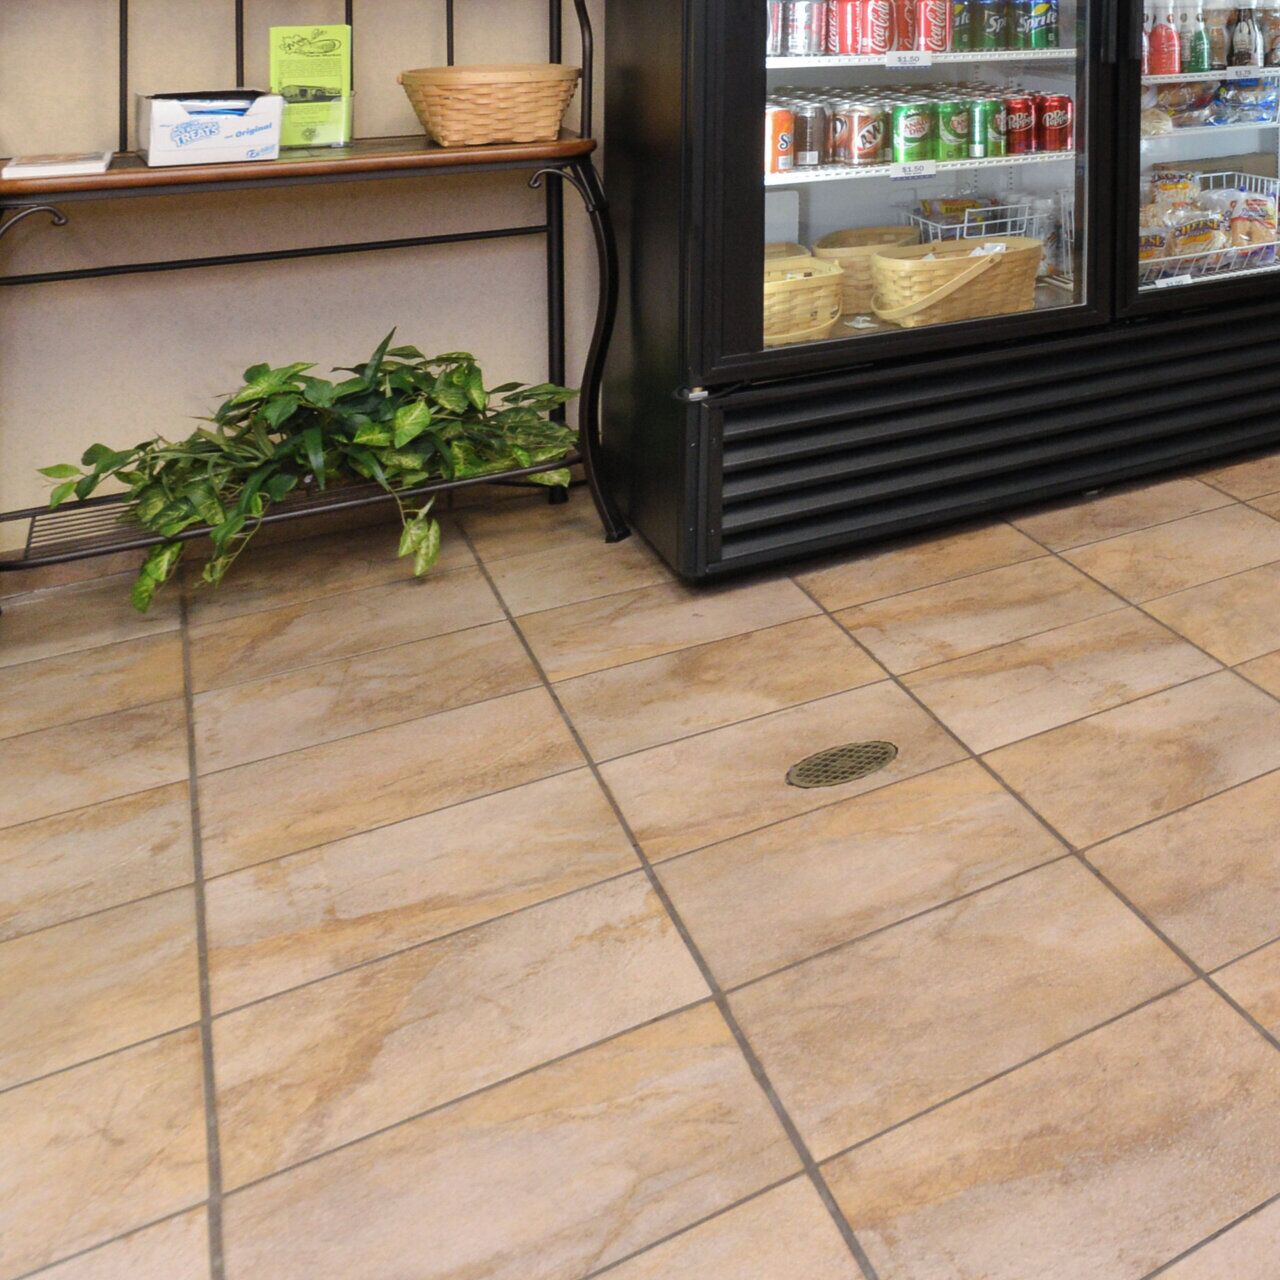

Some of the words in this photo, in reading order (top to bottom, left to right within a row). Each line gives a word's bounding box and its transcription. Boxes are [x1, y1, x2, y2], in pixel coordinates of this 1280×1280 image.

[869, 0, 892, 53] Coca-Cola
[1017, 7, 1058, 34] Sprite
[896, 55, 921, 63] $1.50
[174, 123, 220, 148] TREATS
[234, 122, 273, 139] Original
[859, 120, 883, 149] A&W
[901, 164, 925, 173] $1.50
